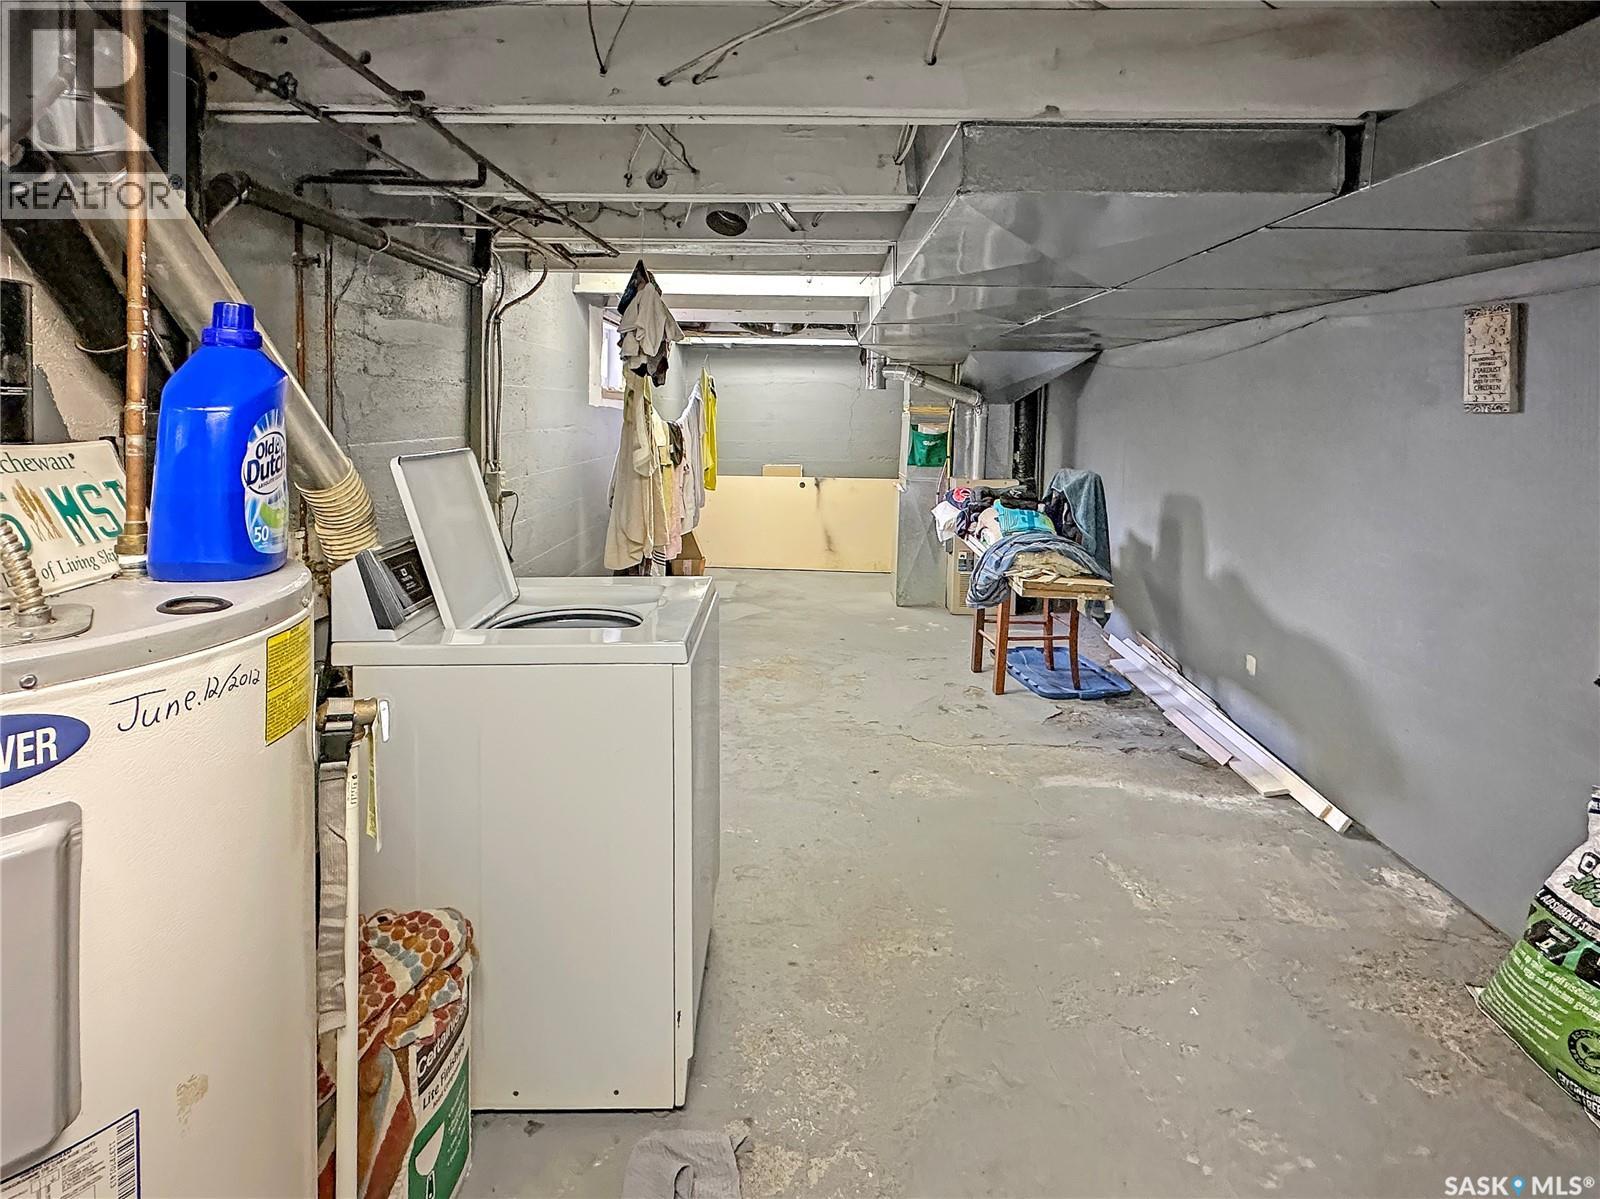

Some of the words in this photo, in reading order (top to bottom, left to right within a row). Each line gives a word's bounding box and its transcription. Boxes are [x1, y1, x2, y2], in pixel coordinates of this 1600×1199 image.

[256, 436, 275, 460] Old
[0, 452, 76, 474] chewan
[247, 447, 286, 486] Dutch
[254, 525, 269, 543] 50
[41, 559, 56, 582] of
[57, 555, 100, 575] Living
